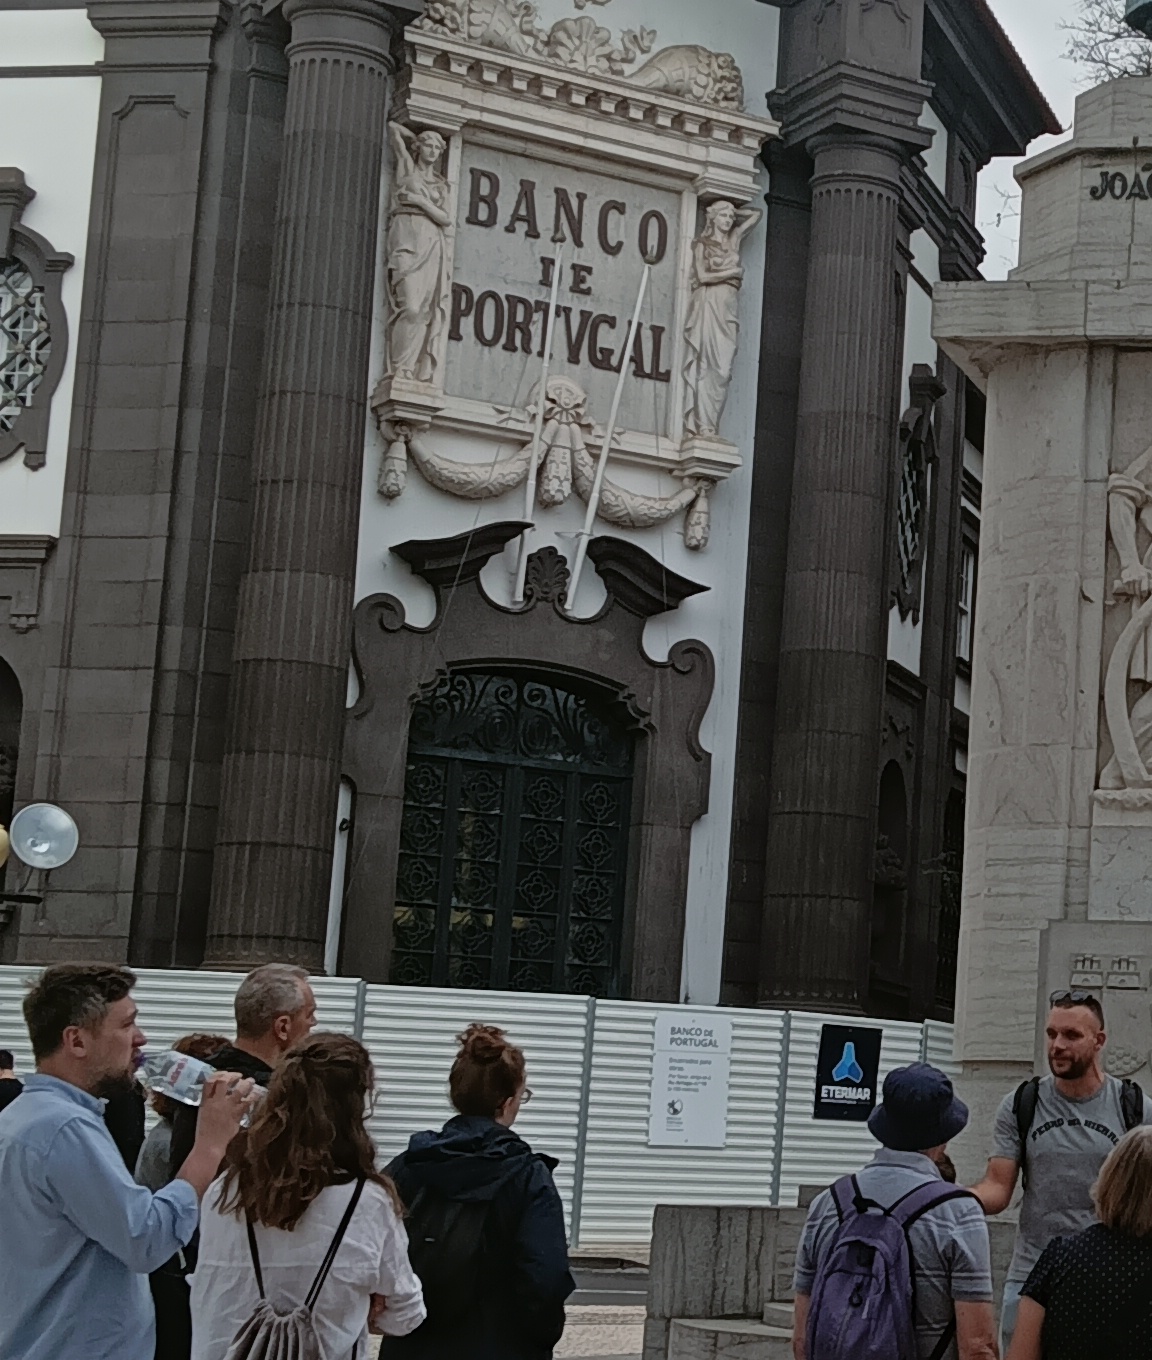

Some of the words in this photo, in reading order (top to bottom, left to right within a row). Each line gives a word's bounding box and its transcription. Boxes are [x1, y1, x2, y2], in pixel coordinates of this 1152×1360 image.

[466, 167, 668, 265] BANCO
[539, 256, 593, 295] DE
[670, 1026, 702, 1036] BANCO
[704, 1029, 713, 1037] DE
[670, 1037, 719, 1048] PORTUGAL
[821, 1085, 871, 1100] ETERMAR
